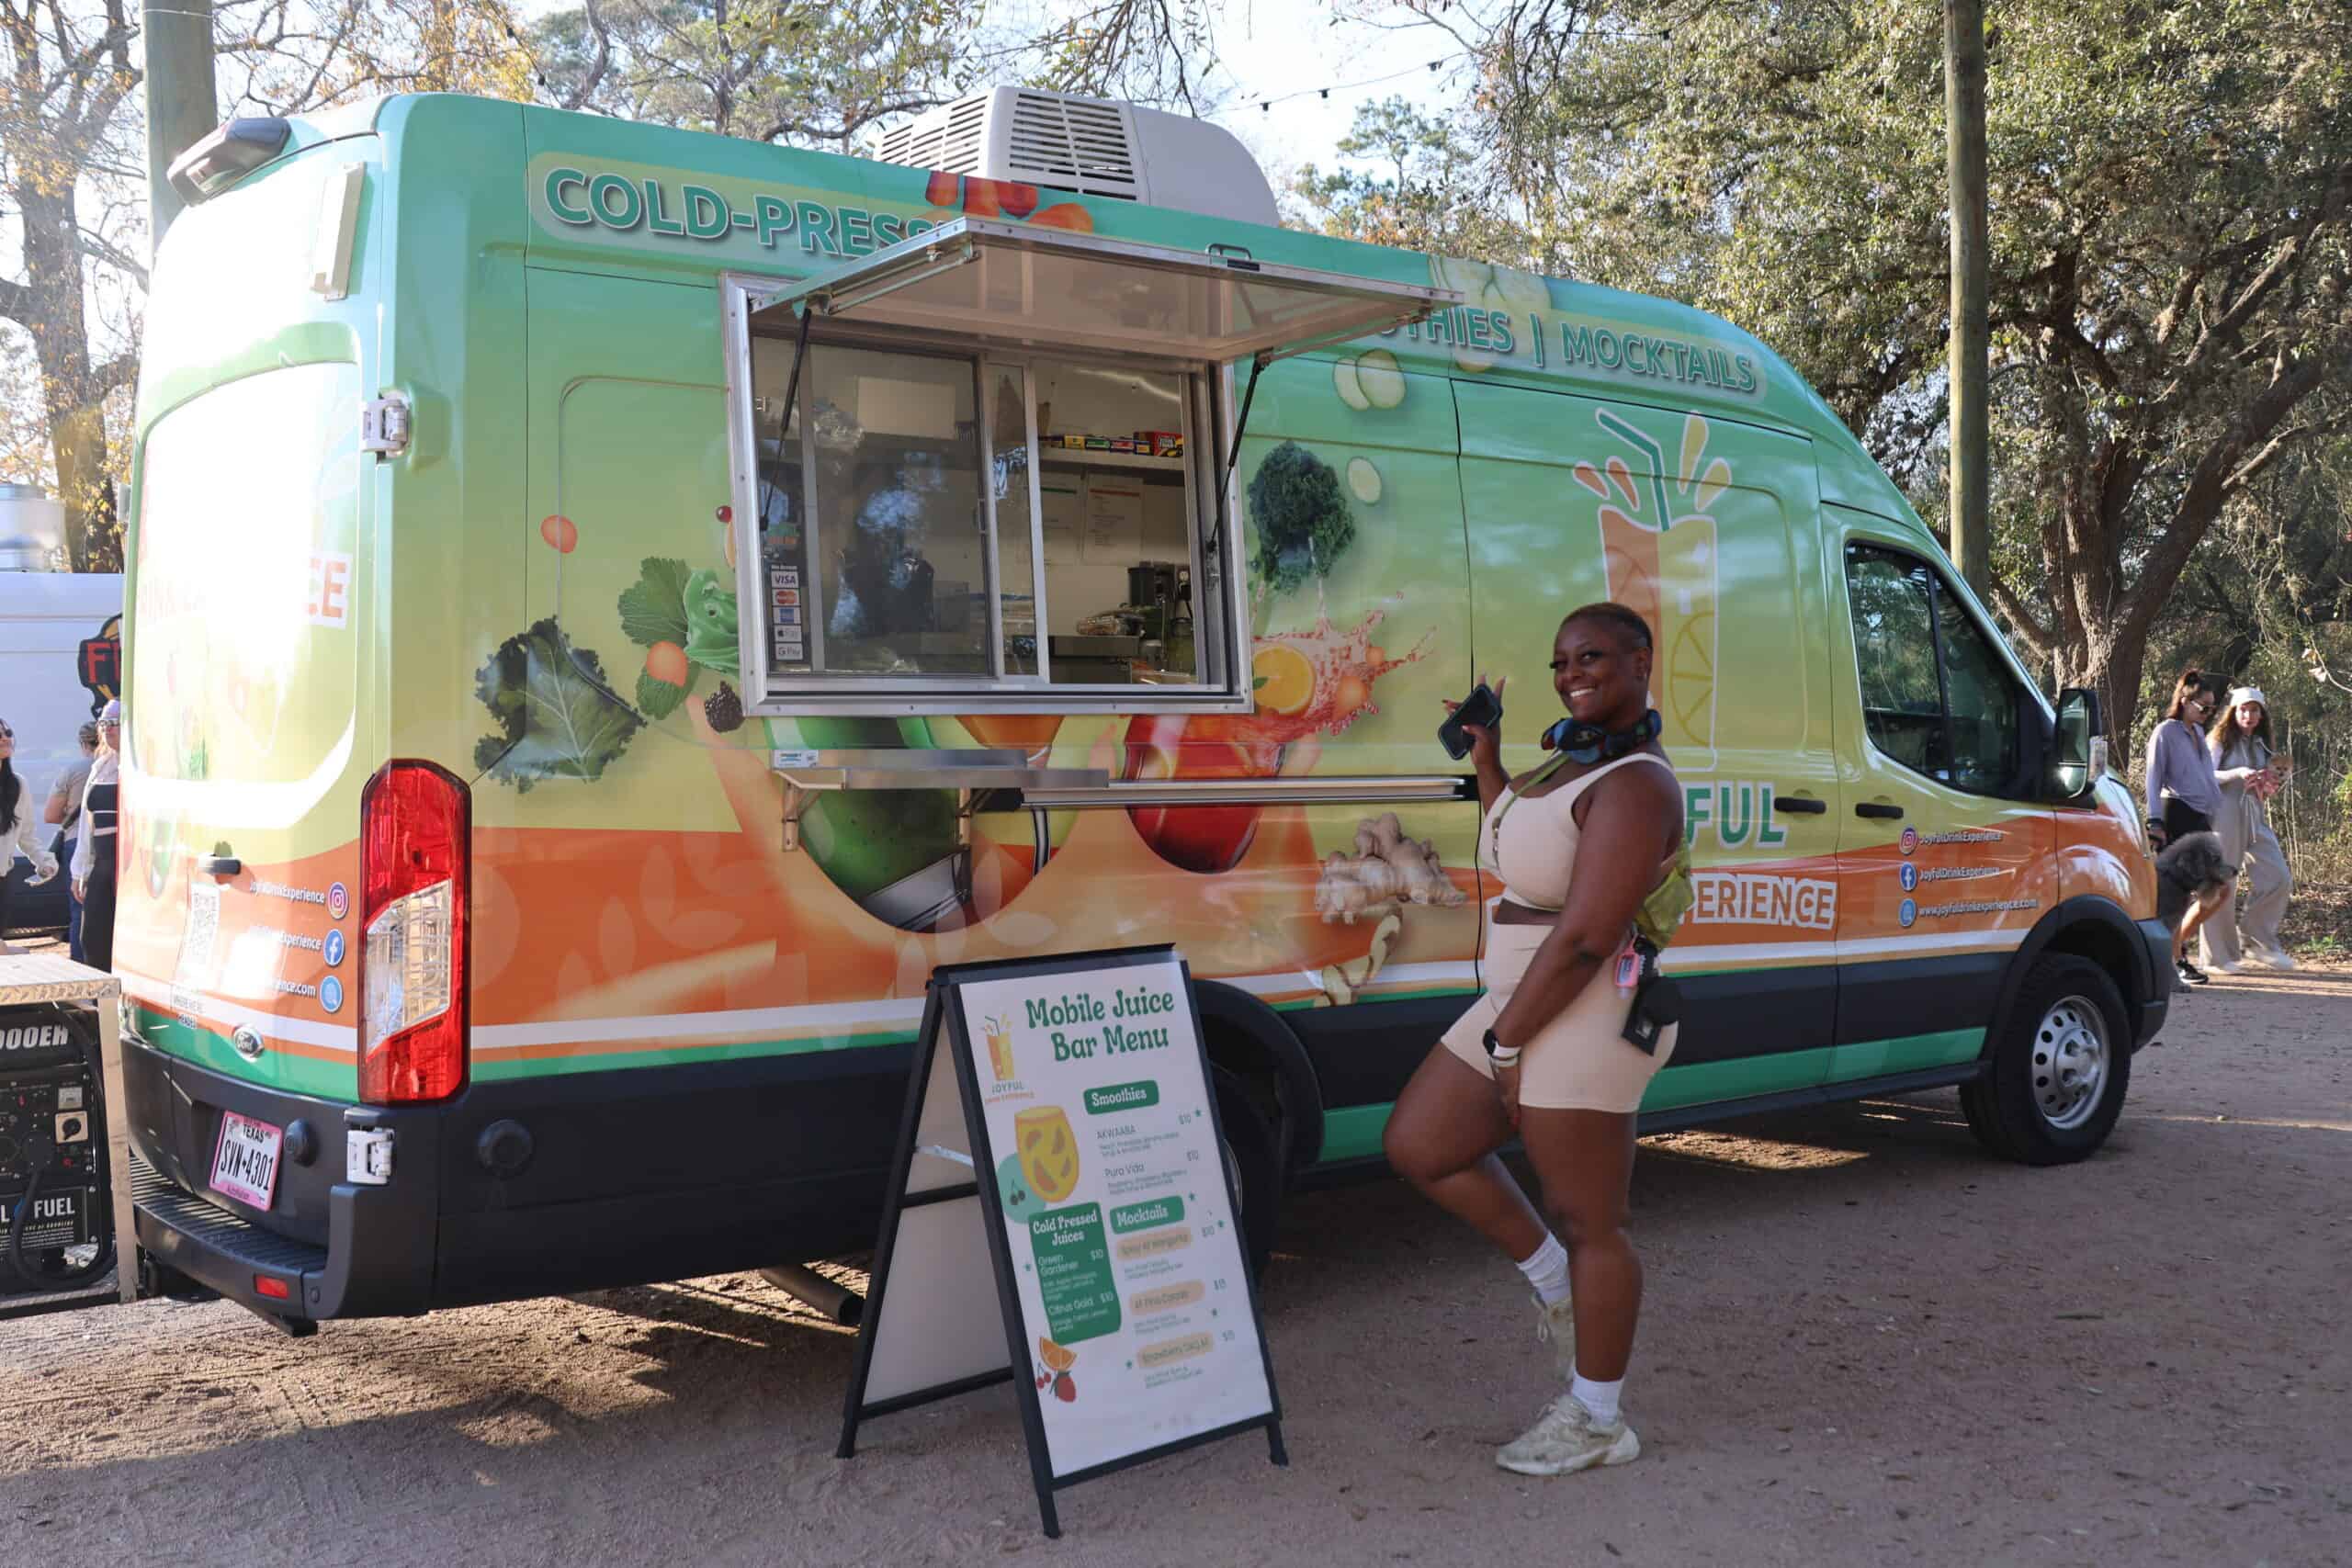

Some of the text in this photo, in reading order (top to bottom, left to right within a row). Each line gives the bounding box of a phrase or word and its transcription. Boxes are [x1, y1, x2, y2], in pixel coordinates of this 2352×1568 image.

[1561, 321, 1755, 392] MOCKTAILS
[775, 575, 796, 585] VISA
[1684, 782, 1788, 848] FUL
[1685, 874, 1837, 930] ERIENCE
[1024, 986, 1175, 1029] Mobile Juice
[1051, 1024, 1170, 1062] Bar Menu
[1091, 1088, 1148, 1106] Smoothies
[243, 1124, 265, 1144] TEXAS
[34, 1197, 75, 1219] FUEL
[1116, 1204, 1169, 1226] Mocktails
[1033, 1210, 1098, 1234] Cold Pressed
[1052, 1231, 1085, 1247] Juices
